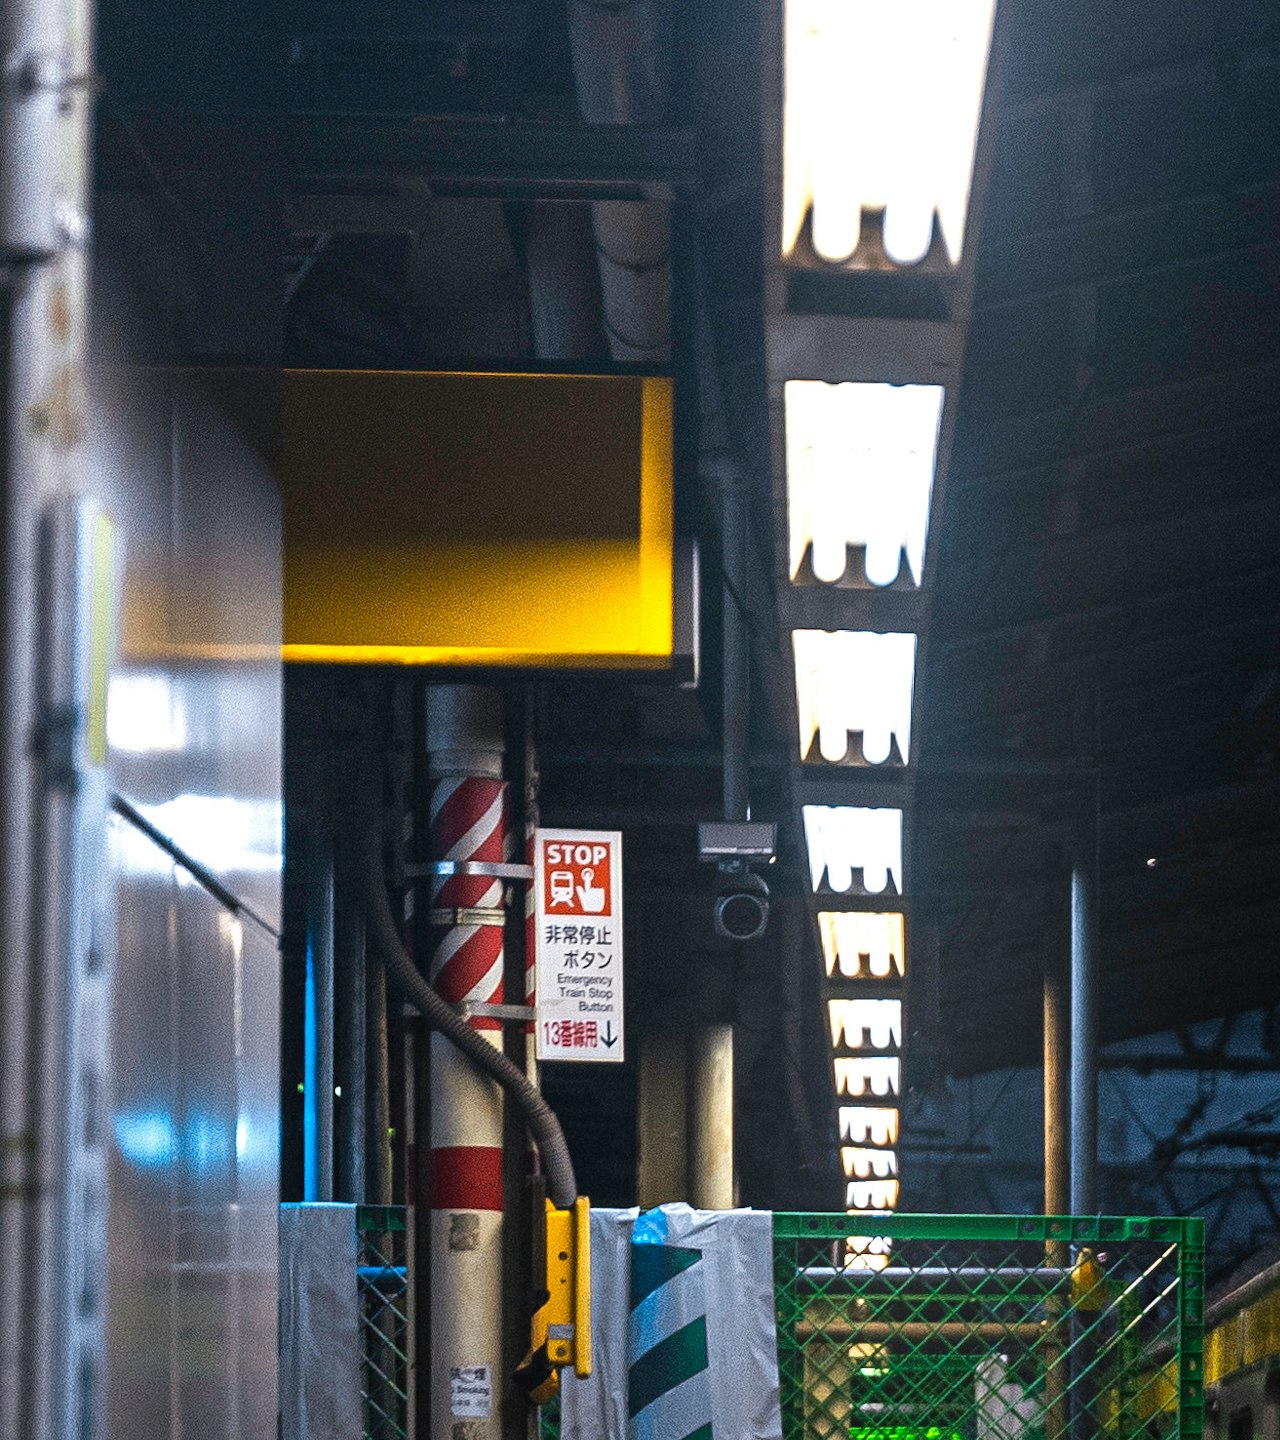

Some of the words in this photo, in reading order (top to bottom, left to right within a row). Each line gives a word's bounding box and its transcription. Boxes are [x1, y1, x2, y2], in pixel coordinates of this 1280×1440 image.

[546, 844, 607, 864] STOP
[545, 925, 612, 945] 非常停止
[563, 950, 613, 969] ボタン
[557, 972, 614, 988] Emergency
[560, 987, 586, 998] Train
[589, 987, 614, 1000] Stop
[578, 1000, 614, 1012] Button
[543, 1019, 598, 1048] 13番線用
